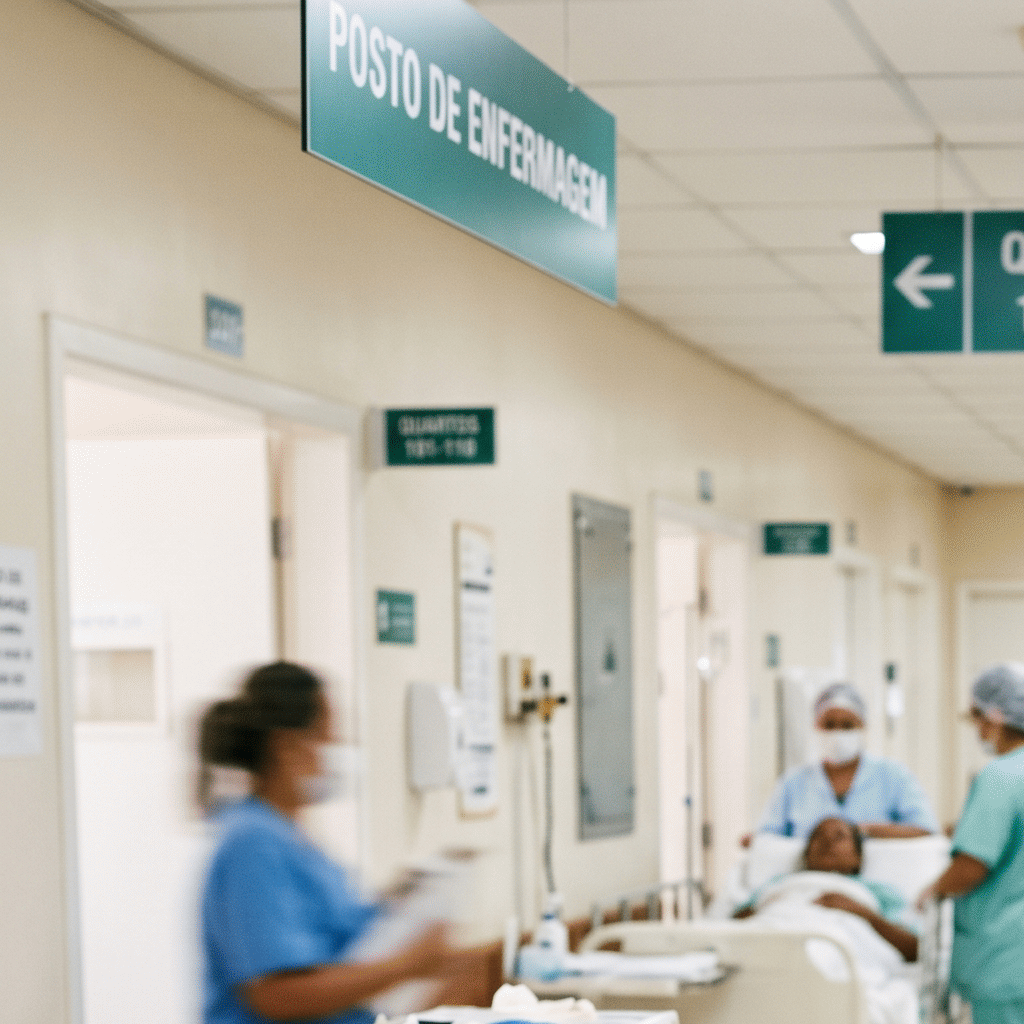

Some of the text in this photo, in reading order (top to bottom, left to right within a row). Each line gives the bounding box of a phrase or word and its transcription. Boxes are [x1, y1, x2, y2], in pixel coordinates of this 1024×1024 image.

[329, 1, 608, 229] POSTO DE ENFERMAGEM
